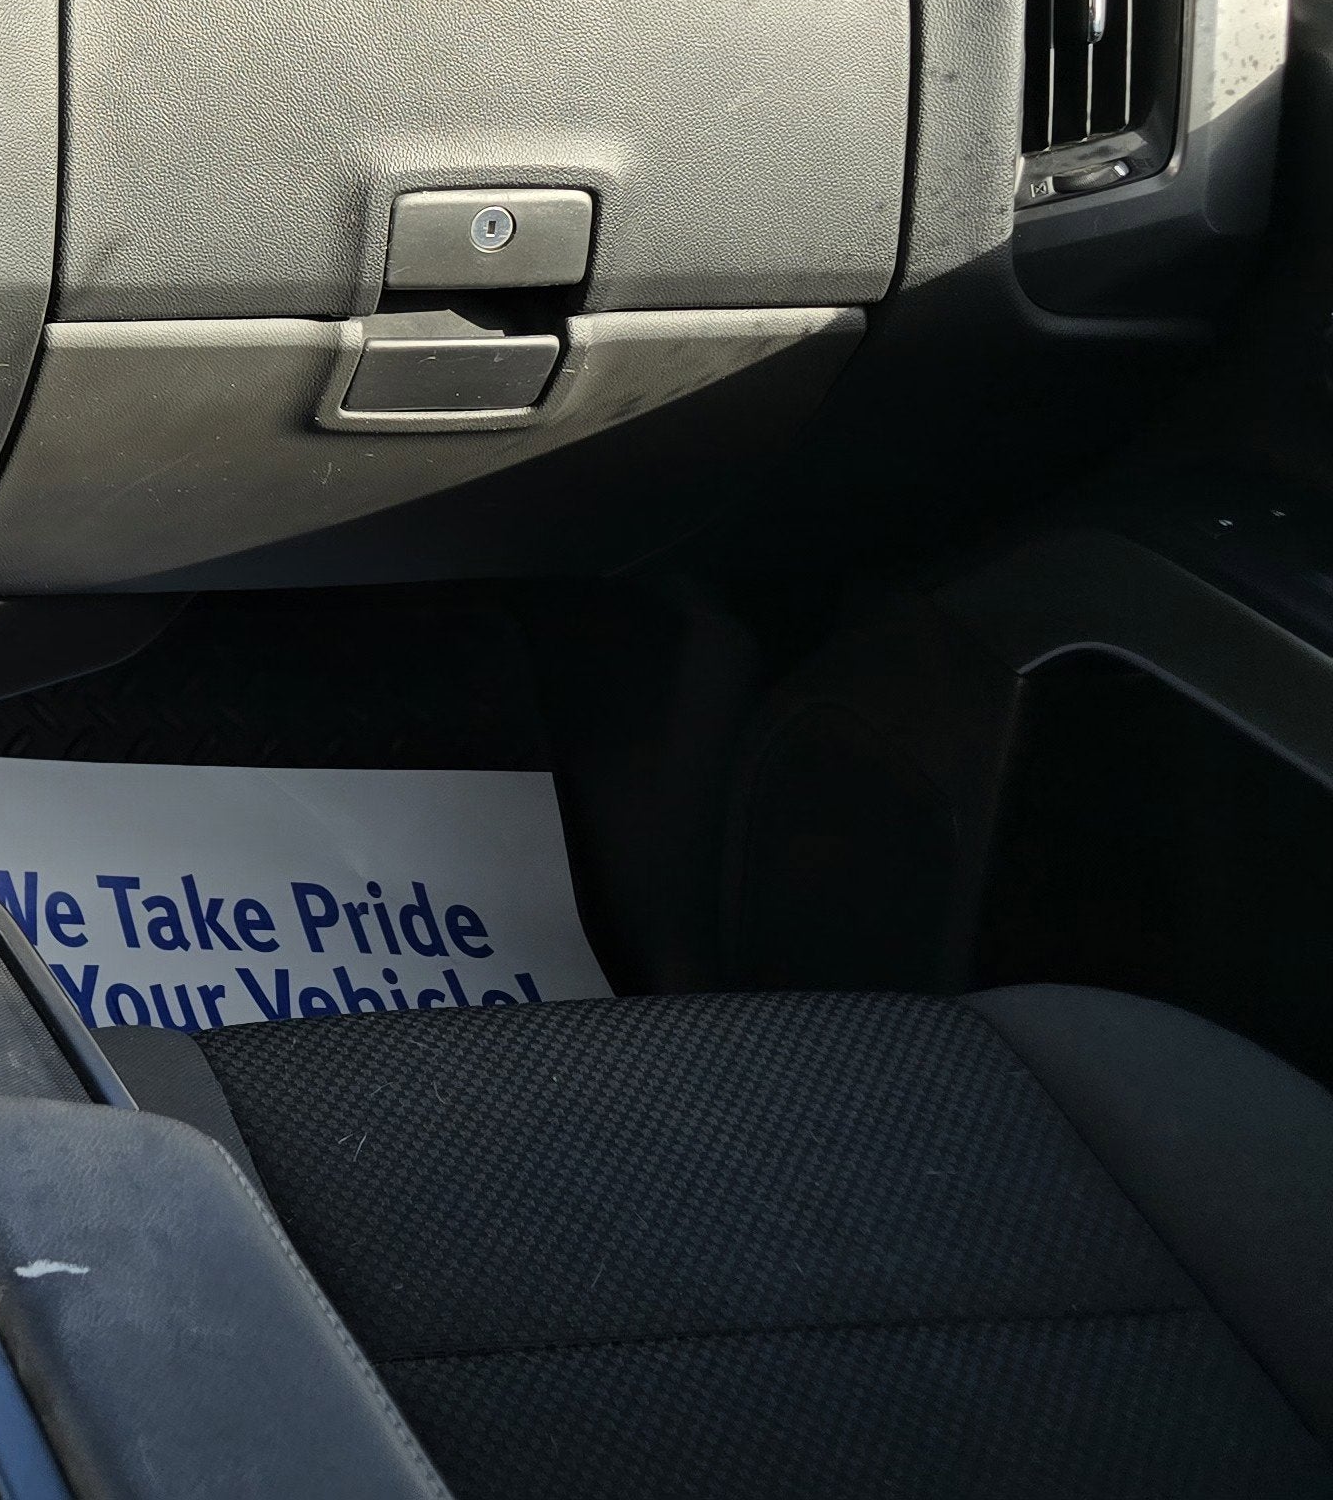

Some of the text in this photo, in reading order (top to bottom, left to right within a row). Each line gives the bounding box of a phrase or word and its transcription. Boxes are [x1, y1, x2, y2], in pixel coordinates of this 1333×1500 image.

[96, 873, 281, 953] Take
[290, 880, 495, 959] Pride
[48, 963, 543, 1034] Your Vehil
